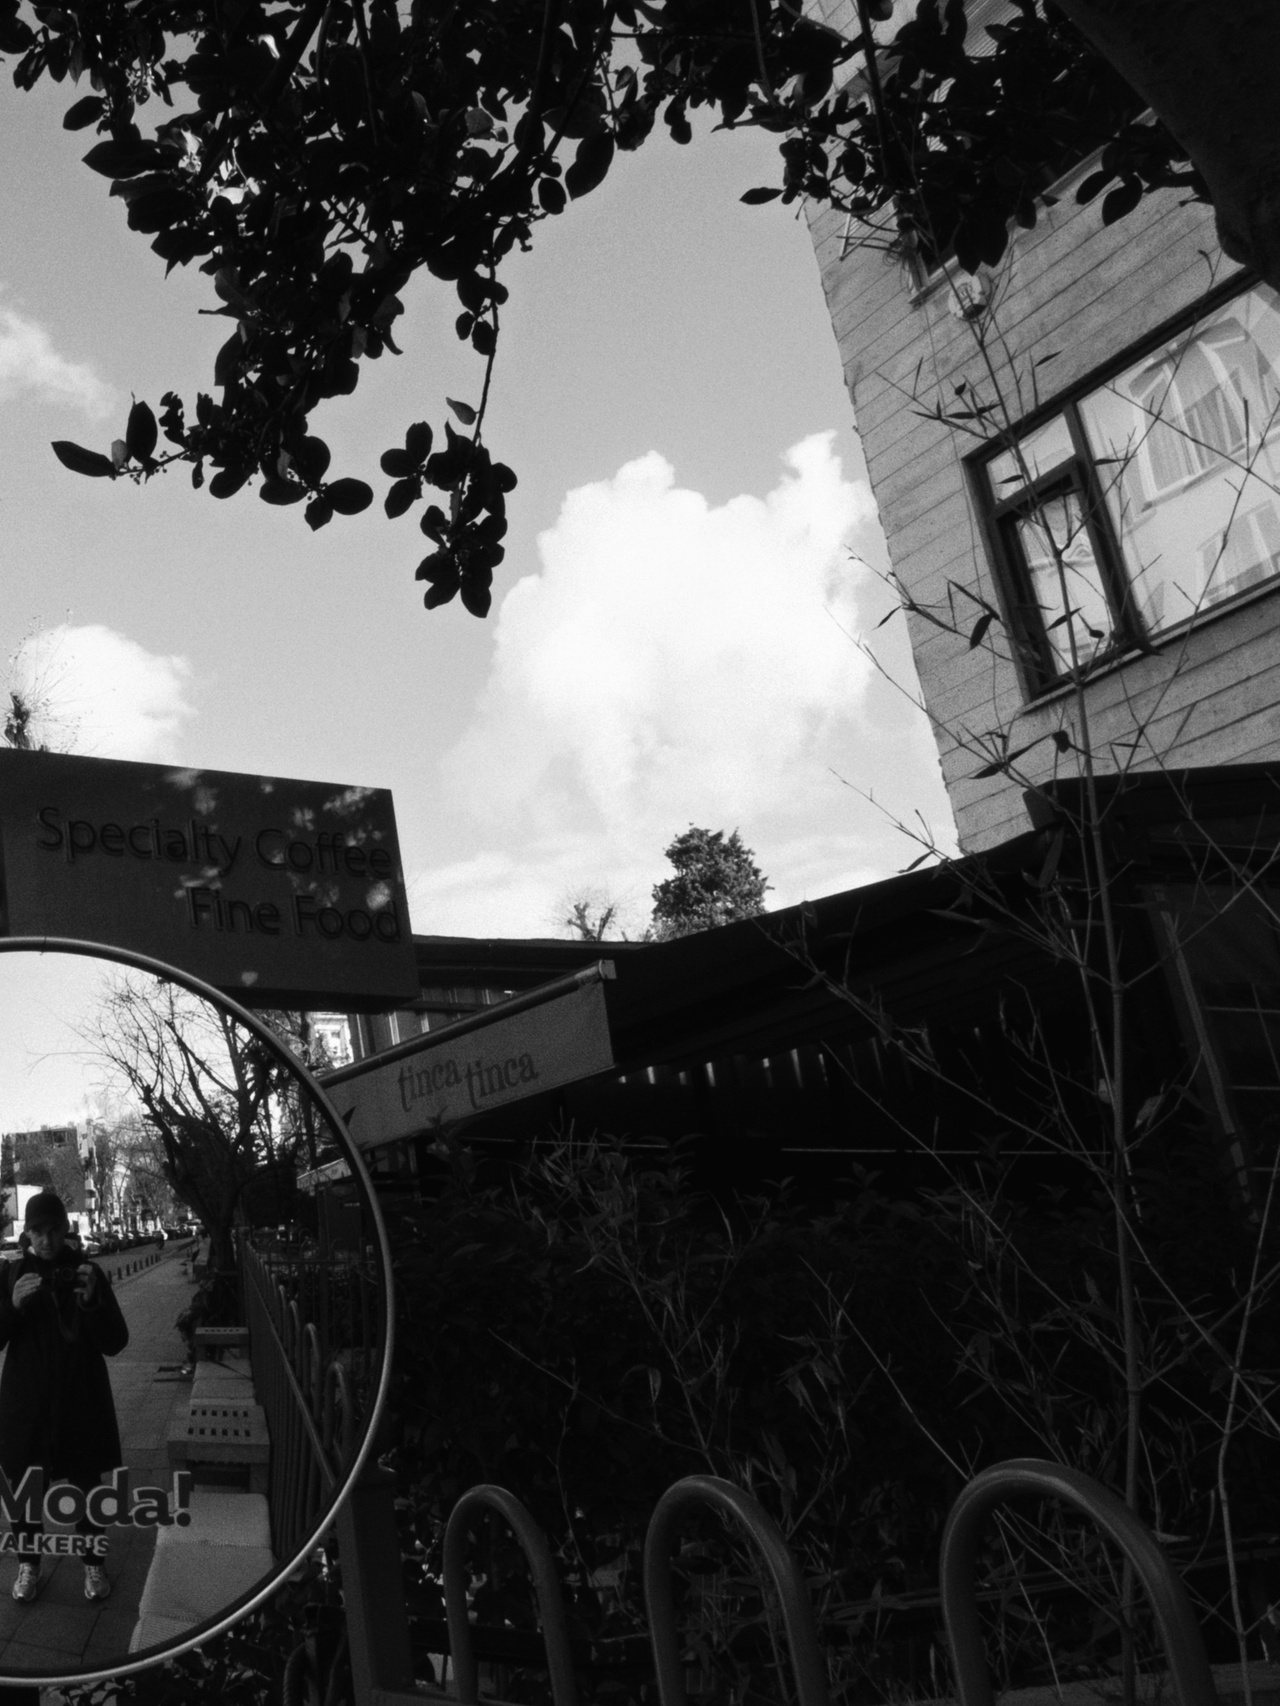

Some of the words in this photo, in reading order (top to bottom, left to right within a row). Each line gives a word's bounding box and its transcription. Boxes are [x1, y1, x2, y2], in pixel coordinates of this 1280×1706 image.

[37, 806, 241, 877] Specialty
[255, 828, 392, 879] Coffee
[186, 886, 280, 934] Fine
[293, 894, 401, 943] Food
[397, 1059, 462, 1113] tinca
[464, 1052, 539, 1109] tinca
